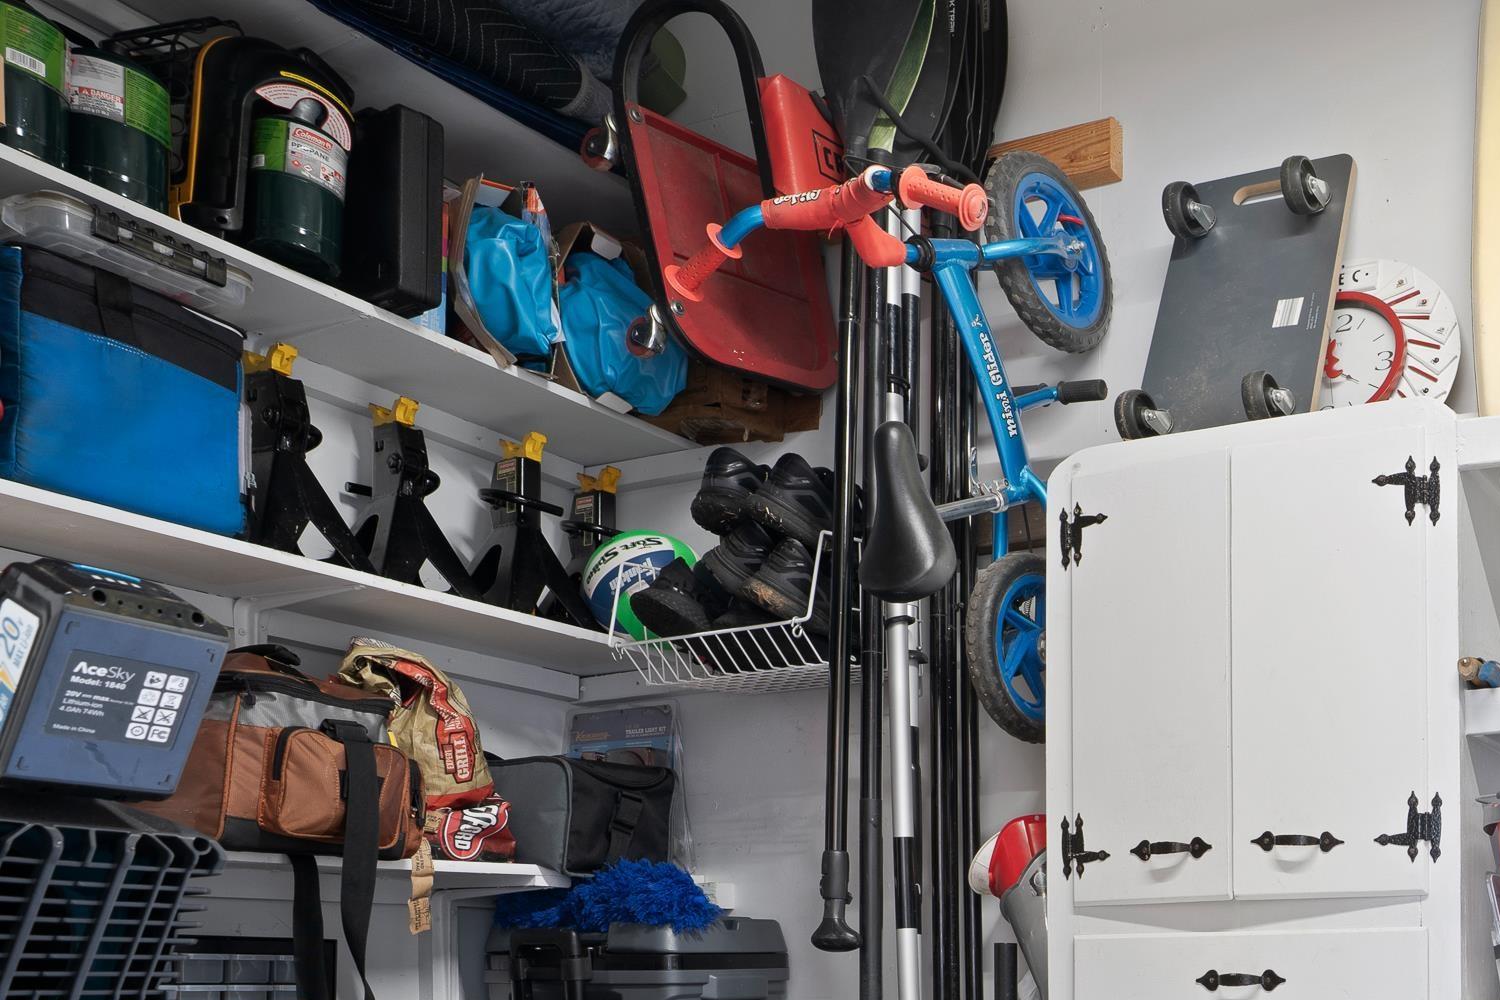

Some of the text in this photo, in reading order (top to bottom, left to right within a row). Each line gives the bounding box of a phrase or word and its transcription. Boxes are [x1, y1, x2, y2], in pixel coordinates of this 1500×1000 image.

[295, 128, 327, 148] Coleman
[979, 332, 1018, 438] mini Glider
[70, 675, 103, 689] Model:
[73, 661, 136, 683] AceSky
[454, 736, 470, 779] GRILL
